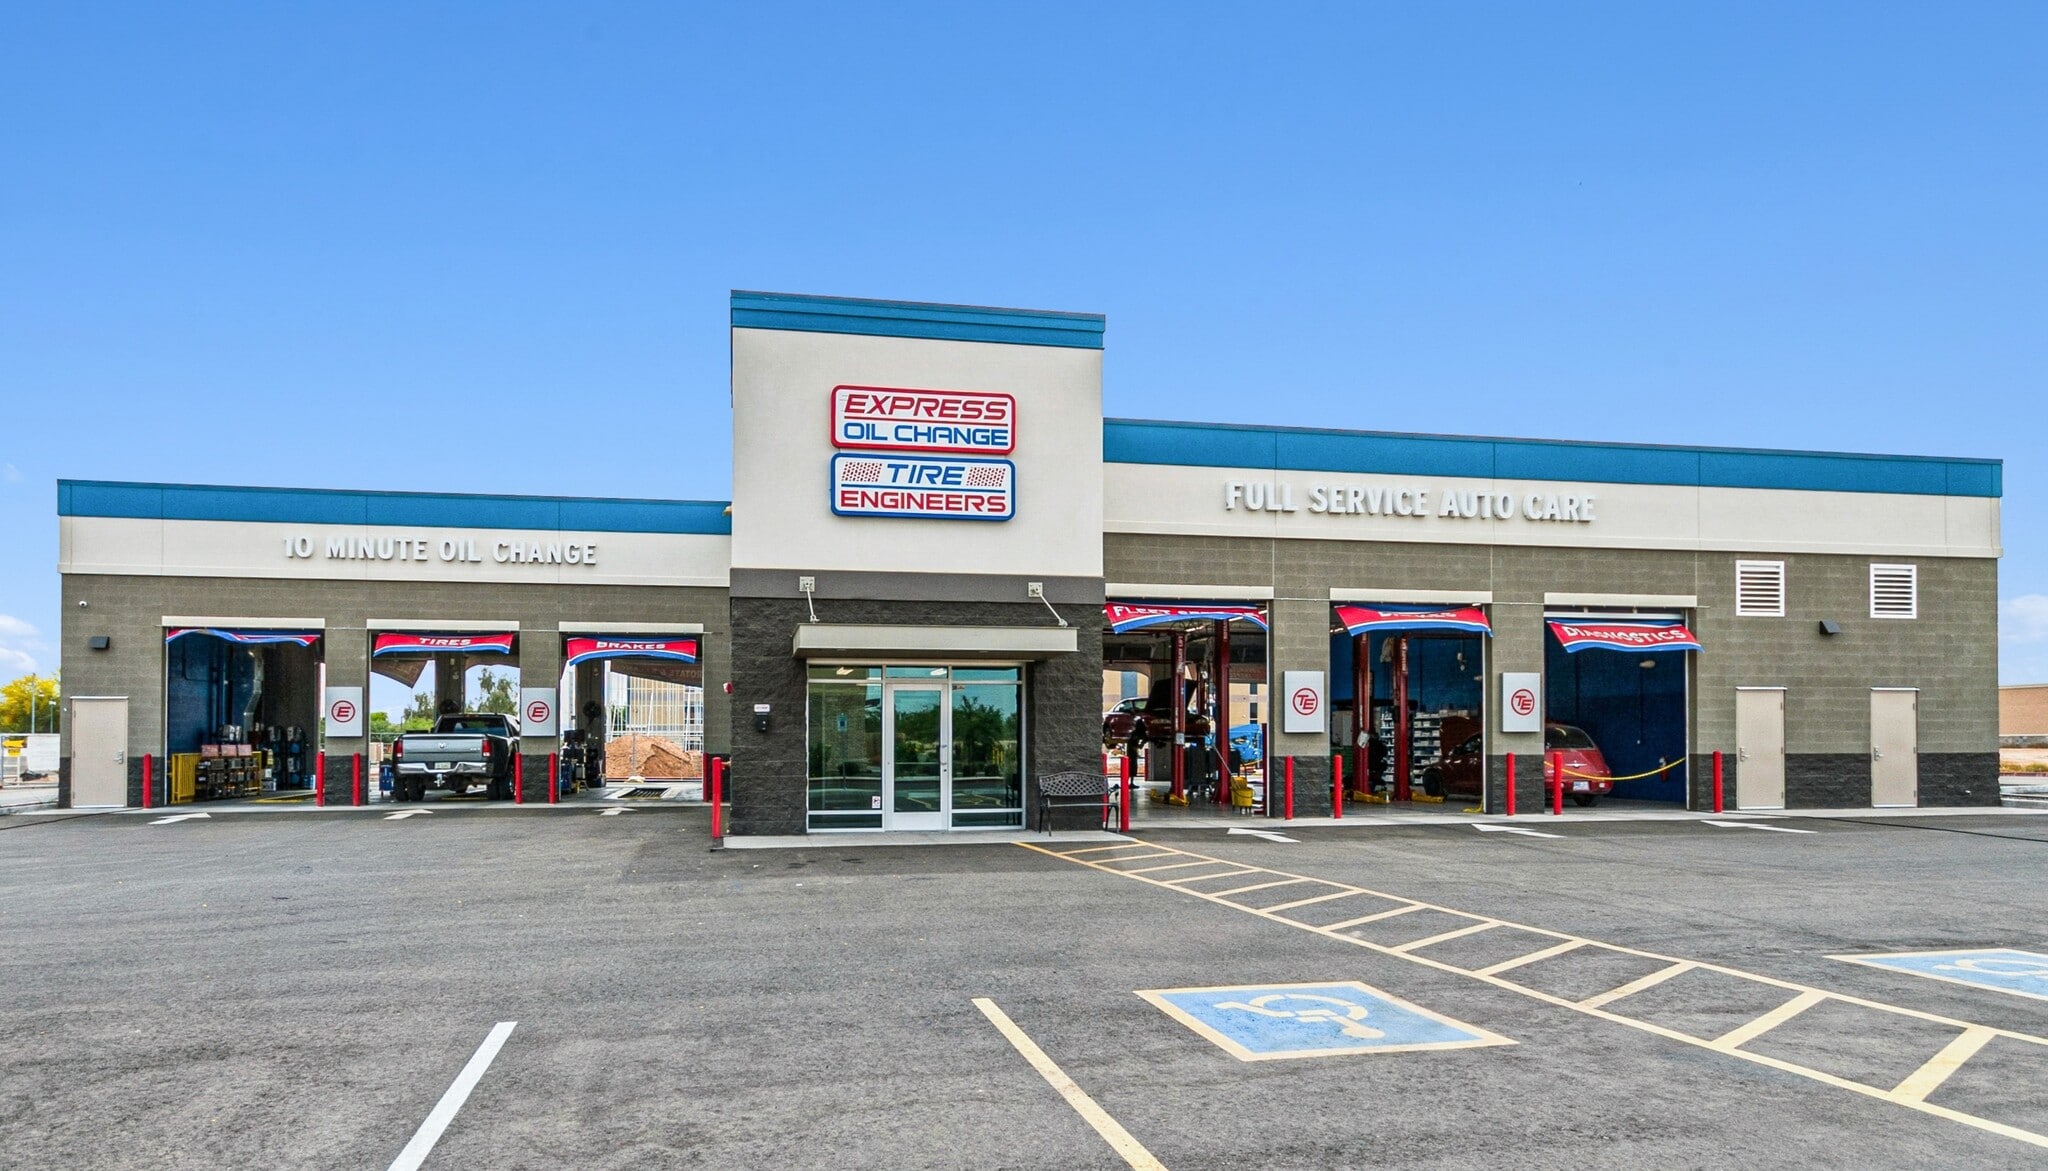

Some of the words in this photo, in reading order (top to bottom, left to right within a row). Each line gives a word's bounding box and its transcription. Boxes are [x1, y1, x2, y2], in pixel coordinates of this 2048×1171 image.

[844, 394, 1008, 420] EXPRESS
[843, 422, 888, 441] OIL
[894, 425, 1008, 446] CHANGE
[887, 463, 965, 485] TIRE
[840, 490, 1006, 512] ENGINEERS
[1225, 481, 1298, 512] FULL
[1309, 483, 1430, 517] SERVICE
[1439, 488, 1514, 520] AUTO
[1522, 492, 1597, 523] CARE
[283, 535, 314, 558] 10
[325, 536, 428, 561] MINUTE
[438, 537, 482, 563] OIL
[493, 539, 597, 565] CHANGE
[419, 637, 471, 646] TIRES
[596, 641, 666, 649] BRAKES
[1561, 626, 1687, 643] DIAGNOSTICS
[336, 706, 352, 717] E
[531, 706, 547, 717] E
